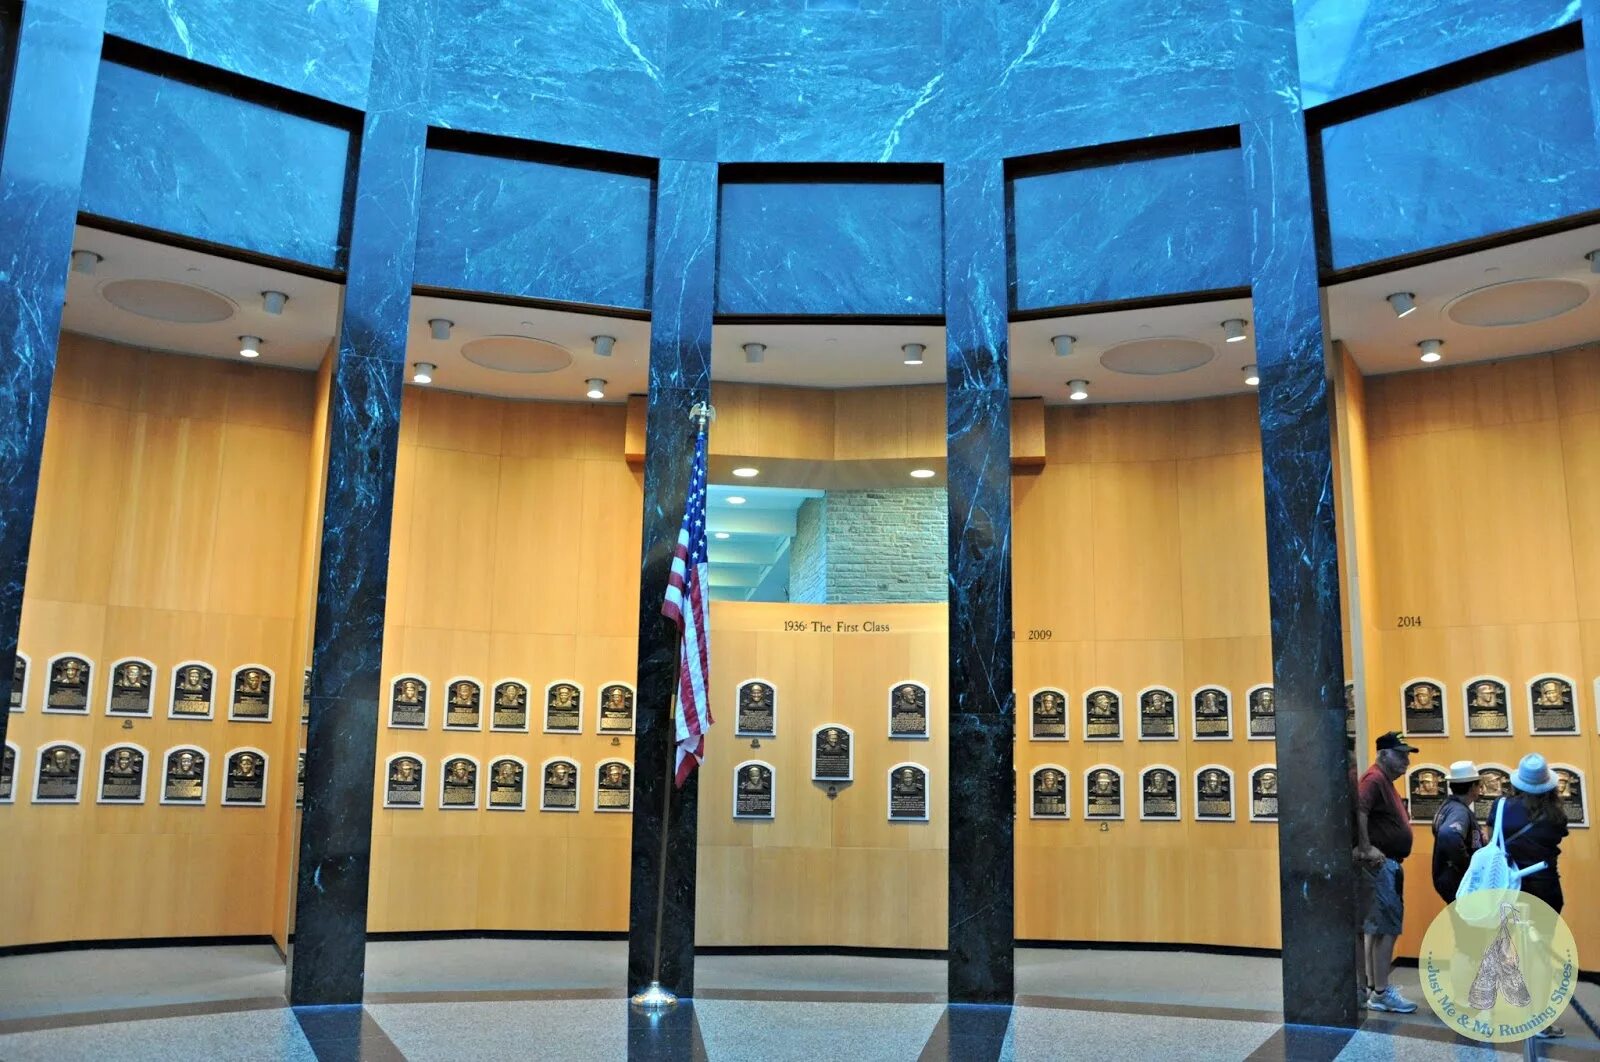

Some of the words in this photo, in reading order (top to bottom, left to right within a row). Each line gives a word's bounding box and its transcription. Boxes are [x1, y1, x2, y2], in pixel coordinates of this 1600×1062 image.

[783, 620, 808, 632] 1936:
[810, 620, 832, 633] The
[836, 620, 860, 632] First
[862, 620, 890, 632] Class
[1397, 615, 1422, 628] 2014
[1028, 629, 1052, 641] 2009
